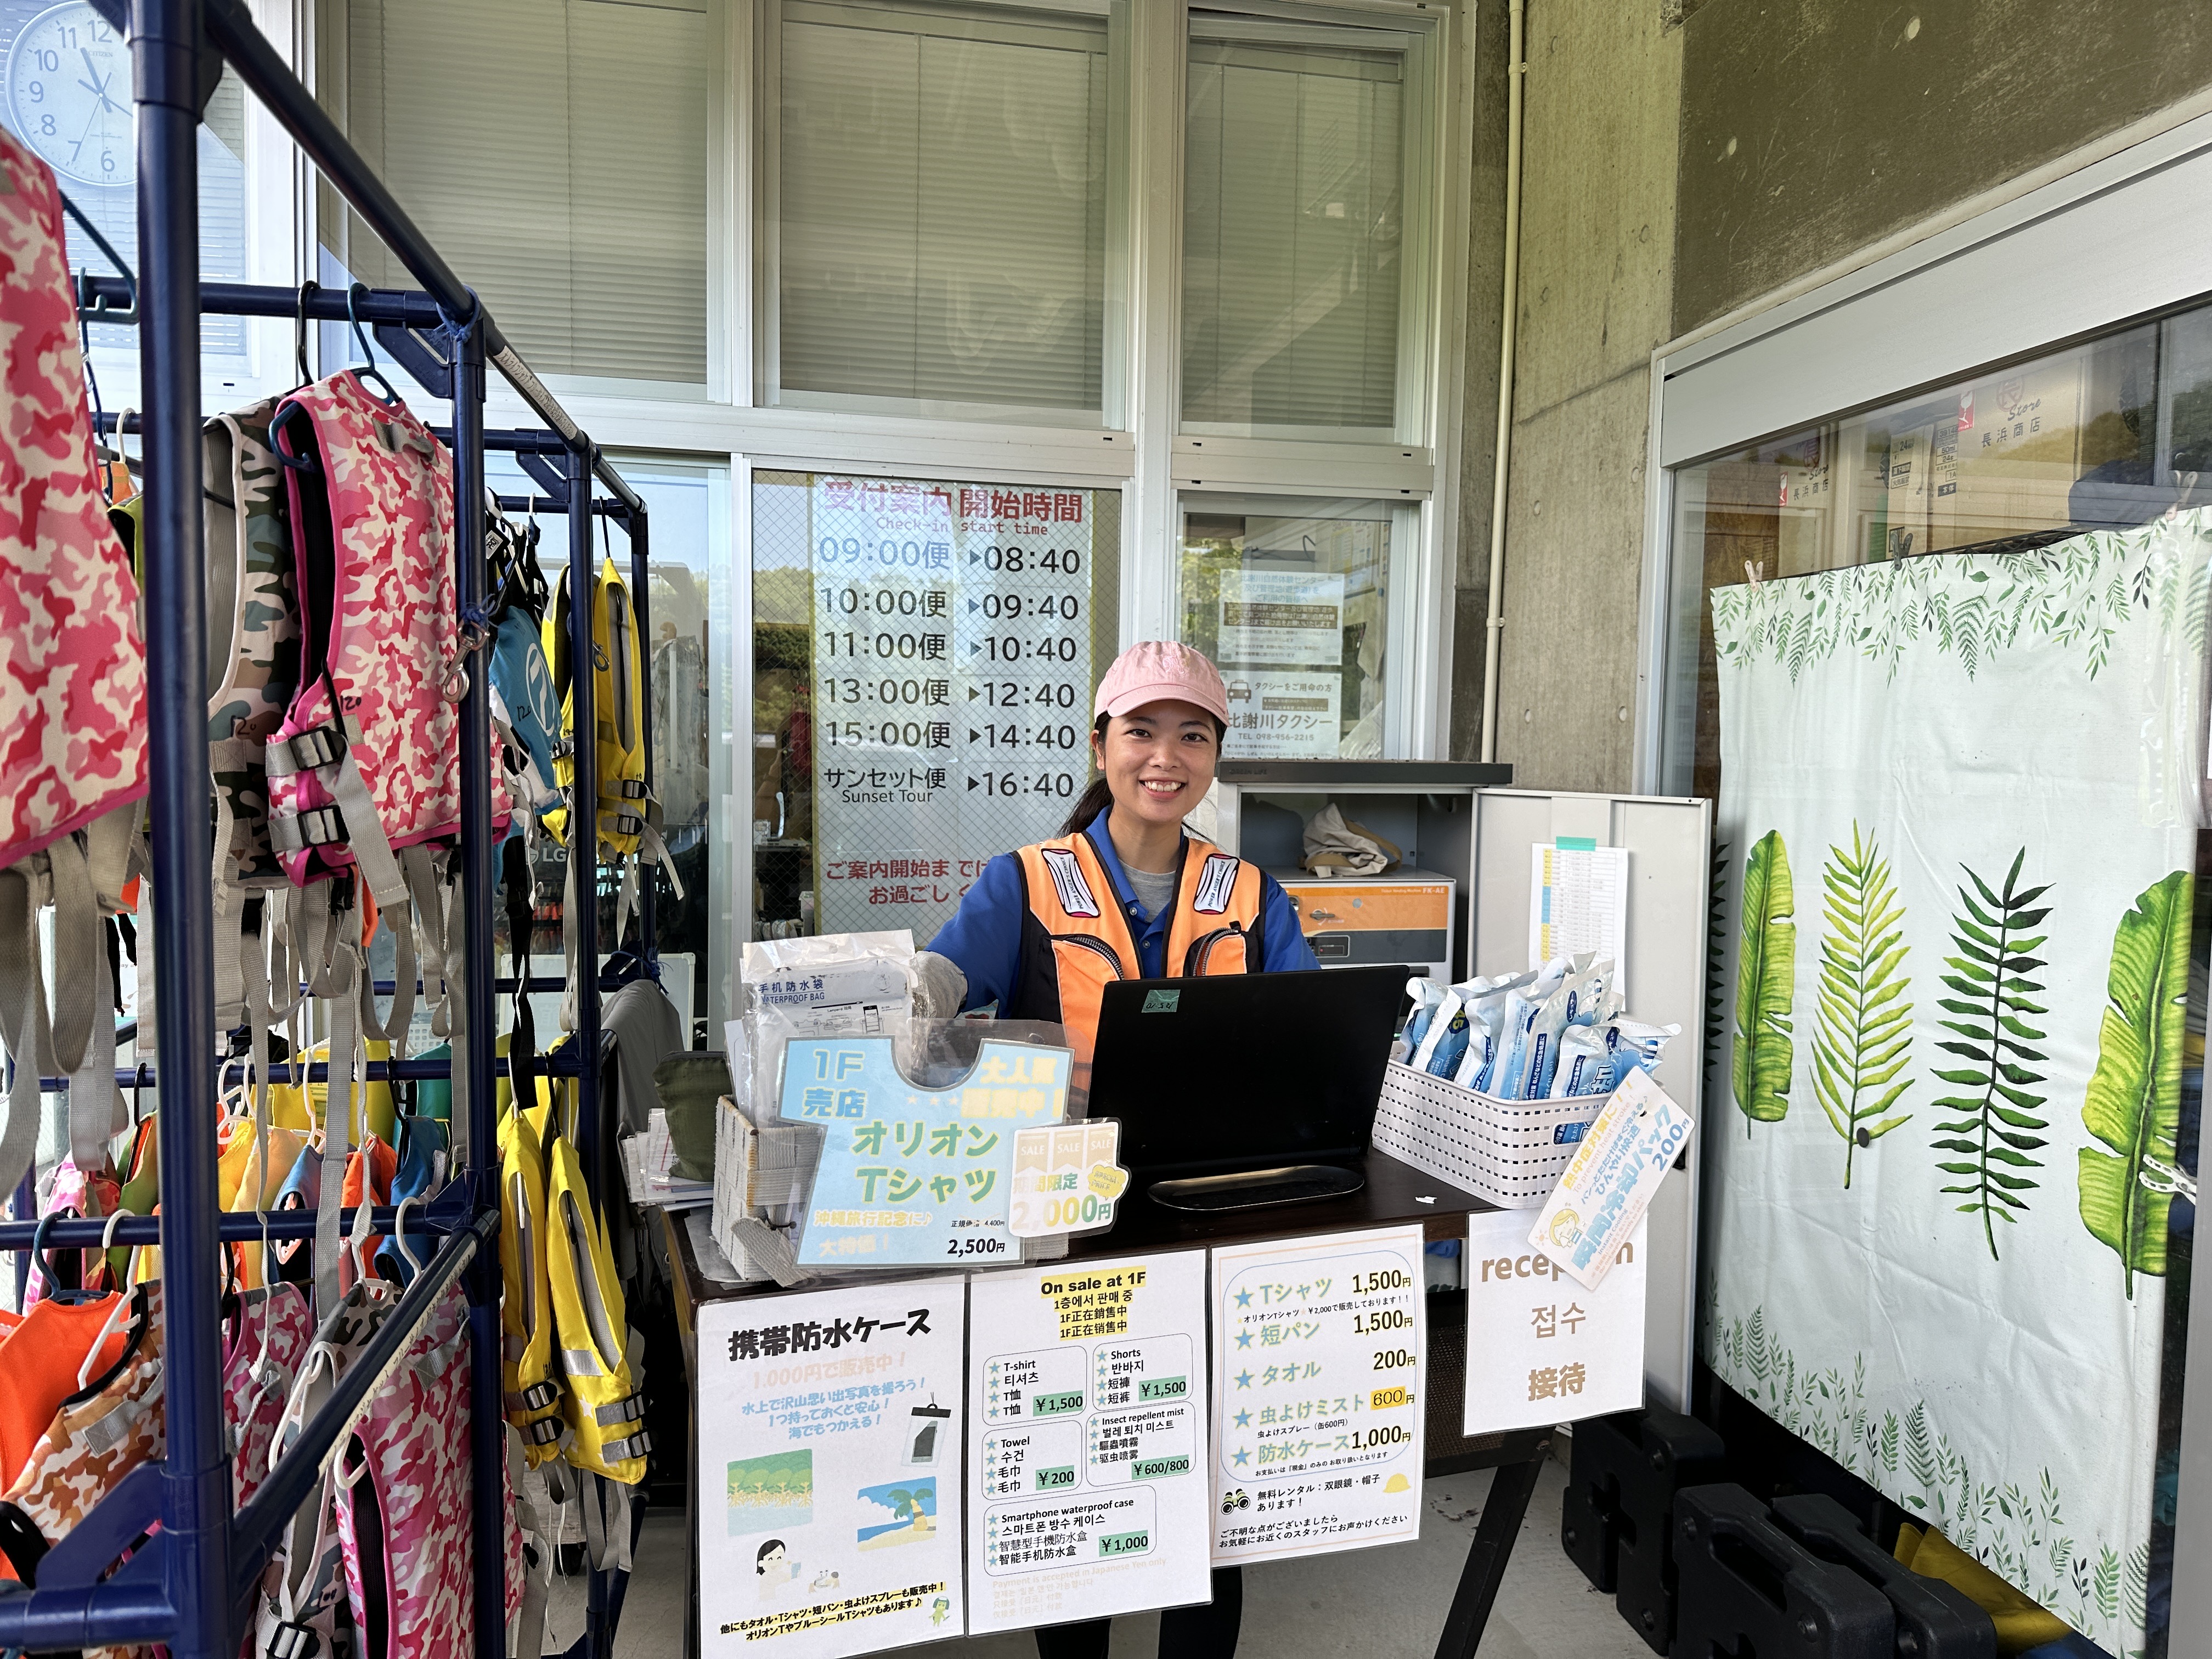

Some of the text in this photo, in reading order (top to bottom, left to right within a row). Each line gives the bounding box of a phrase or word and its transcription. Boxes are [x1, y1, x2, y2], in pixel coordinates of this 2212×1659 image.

[58, 26, 77, 49] 11
[87, 20, 112, 43] 12
[34, 49, 59, 72] 10
[29, 81, 44, 103] 9
[41, 114, 56, 136] 8
[100, 150, 115, 172] 6
[2008, 399, 2041, 421] Store
[1982, 416, 2040, 448] 長浜商店
[1794, 478, 1829, 500] 長浜商店
[876, 516, 1048, 536] Check-in start time
[819, 537, 1080, 574] 09:00便 08:40
[820, 587, 1078, 620] 10:00便 09:40
[824, 631, 1076, 662] 11:00便 10:40
[824, 678, 1074, 707] 13:00便 12:40
[1255, 682, 1332, 692] タクシーをご用命の方
[340, 695, 362, 712] 120
[1228, 713, 1333, 730] 比謝川タクシー
[826, 721, 1075, 749] 15:00便 14:40
[824, 767, 1074, 797] サンセット便 16:40
[842, 790, 933, 803] Sunset Tour
[543, 848, 567, 862] LG
[1073, 894, 1084, 909] POWER
[759, 979, 823, 993] 手机防水袋
[810, 992, 825, 1001] BAG
[814, 1049, 865, 1081] 1F
[803, 1088, 866, 1118] 売店
[851, 1121, 998, 1157] オリオン
[1021, 1145, 1045, 1155] SALE
[1058, 1143, 1080, 1153] SALE
[1091, 1139, 1111, 1149] SALE
[1573, 1101, 1632, 1193] To prevent heat stroke
[1651, 1114, 1691, 1171] 200円
[1595, 1124, 1641, 1196] ひんやり快適
[855, 1167, 997, 1204] Tシャツ
[1569, 1103, 1677, 1271] 瞬間冷却パック
[1012, 1194, 1111, 1231] 2,000円
[1598, 1208, 1629, 1255] Instant Cooling
[947, 1238, 1005, 1257] 2,500円
[1041, 1272, 1146, 1295] On sale at 1F
[1260, 1269, 1411, 1304] Tシャツ 1,500円
[1054, 1289, 1133, 1309] 1층에서 판매 중
[1060, 1306, 1127, 1323] 1F正在銷售中
[1244, 1309, 1299, 1323] オリオンTシャツ
[1531, 1302, 1586, 1339] 접수
[728, 1308, 932, 1362] 携帯防水ケース
[1060, 1320, 1127, 1338] 1F正在销售中
[1261, 1310, 1413, 1346] 短パン 1,500円
[1111, 1348, 1141, 1360] Shorts
[1004, 1360, 1036, 1372] T-shirt
[1111, 1360, 1144, 1375] 반바지
[1262, 1349, 1415, 1386] タオル 200円
[1005, 1372, 1039, 1386] 티셔츠
[1528, 1362, 1585, 1402] 接待
[1003, 1389, 1021, 1401] T恤
[1108, 1392, 1130, 1405] 短裤
[1003, 1403, 1021, 1416] T恤
[1102, 1407, 1184, 1425] Insect repellent mist
[1260, 1395, 1364, 1425] 虫よけミスト
[1102, 1420, 1175, 1438] 벌레 퇴치 미스트
[1001, 1436, 1030, 1448] Towel
[1258, 1425, 1411, 1464] 防水ケース 1,000円
[1001, 1449, 1024, 1464] 수건
[997, 1466, 1020, 1478] 毛巾
[997, 1480, 1020, 1493] 毛巾
[1257, 1474, 1380, 1501] 無料レンタル：双眼鏡・帽子
[1002, 1499, 1134, 1524] Smartphone waterproof case
[1257, 1497, 1302, 1512] あります！
[1002, 1514, 1105, 1537] 스마트폰 방수 케이스
[1219, 1515, 1408, 1548] お気軽にお近くのスタッフにお声かけください
[1221, 1514, 1338, 1538] ご不明な点がございましたら
[999, 1531, 1087, 1553] 智慧型手機防水盒
[999, 1545, 1076, 1566] 智能手机防水盒
[992, 1576, 1030, 1590] Payment
[1033, 1575, 1040, 1583] is
[1042, 1570, 1080, 1583] accepted
[1092, 1564, 1130, 1577] Japanese
[1132, 1560, 1147, 1568] Yen
[1149, 1558, 1167, 1568] only
